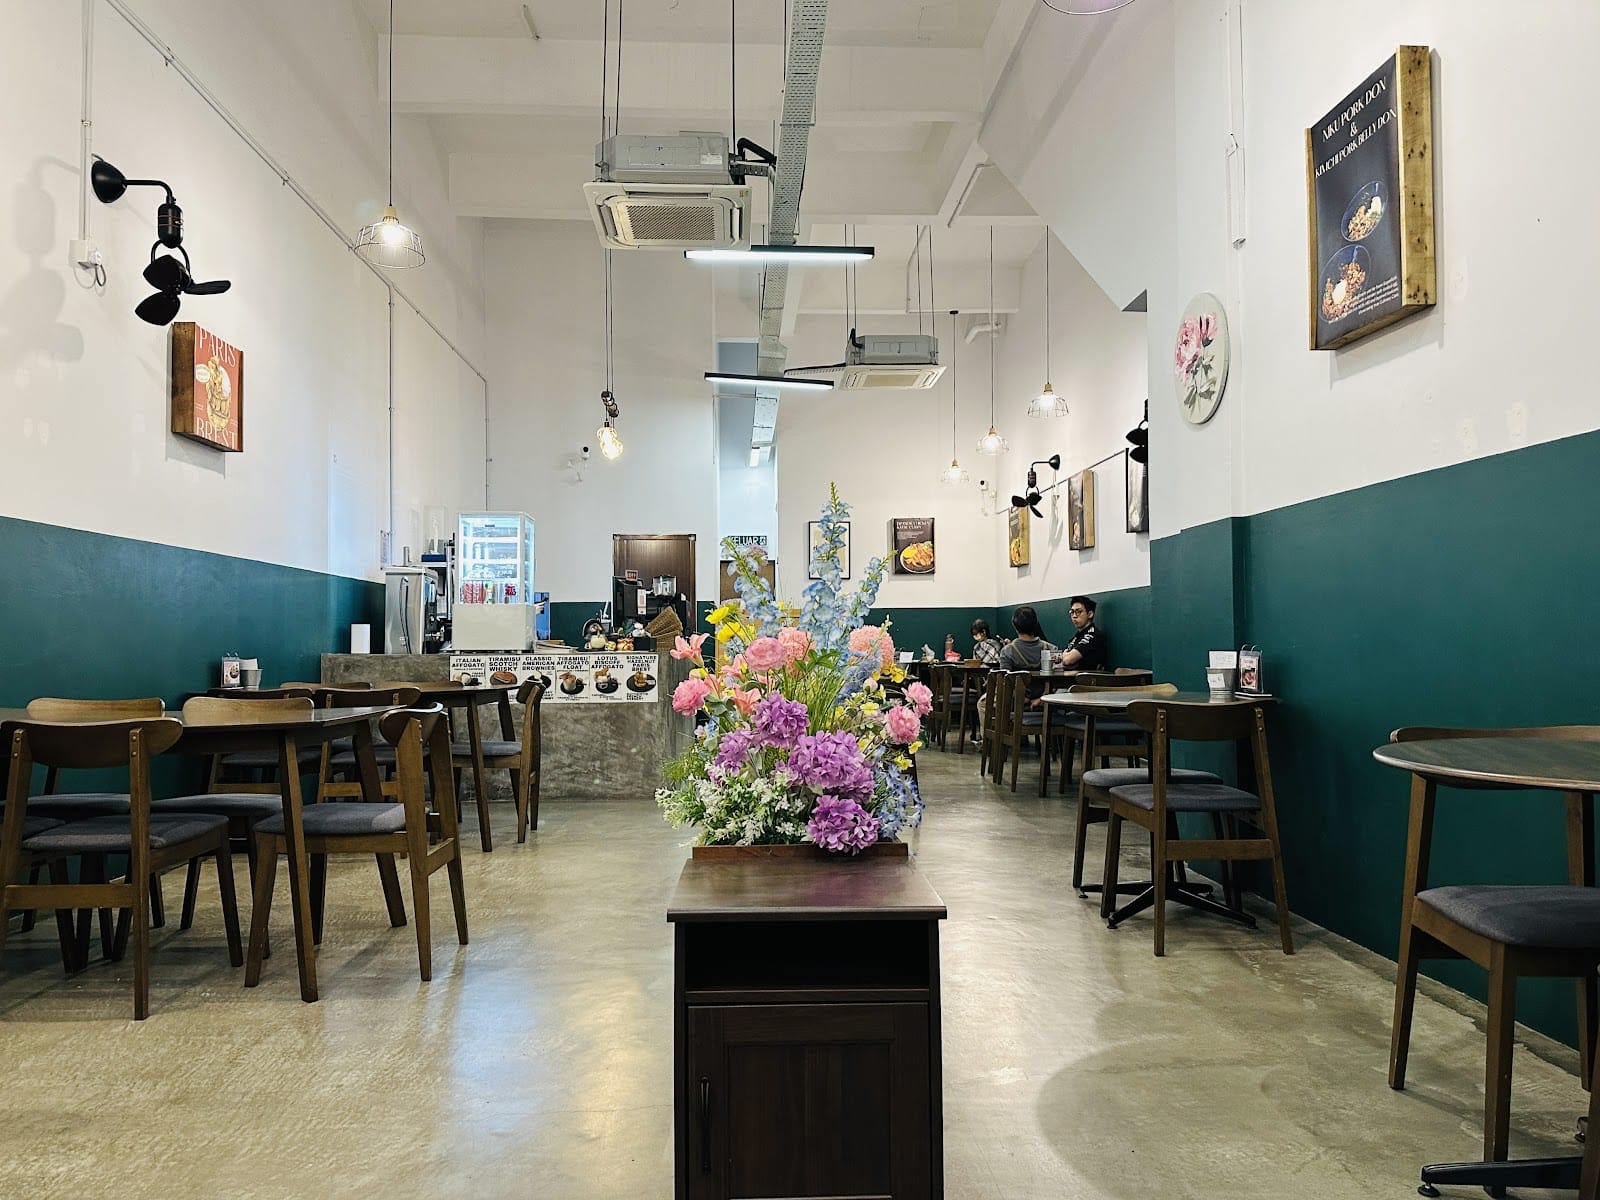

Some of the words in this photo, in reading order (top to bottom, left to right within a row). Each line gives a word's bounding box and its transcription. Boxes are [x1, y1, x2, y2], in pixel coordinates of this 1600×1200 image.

[1341, 96, 1364, 127] PORK
[1365, 76, 1386, 105] DON
[1339, 140, 1358, 162] PORK
[1358, 120, 1377, 146] BELLY
[1377, 108, 1397, 129] DON
[1350, 121, 1358, 137] &
[199, 326, 236, 368] PARIS
[196, 417, 236, 450] BREST
